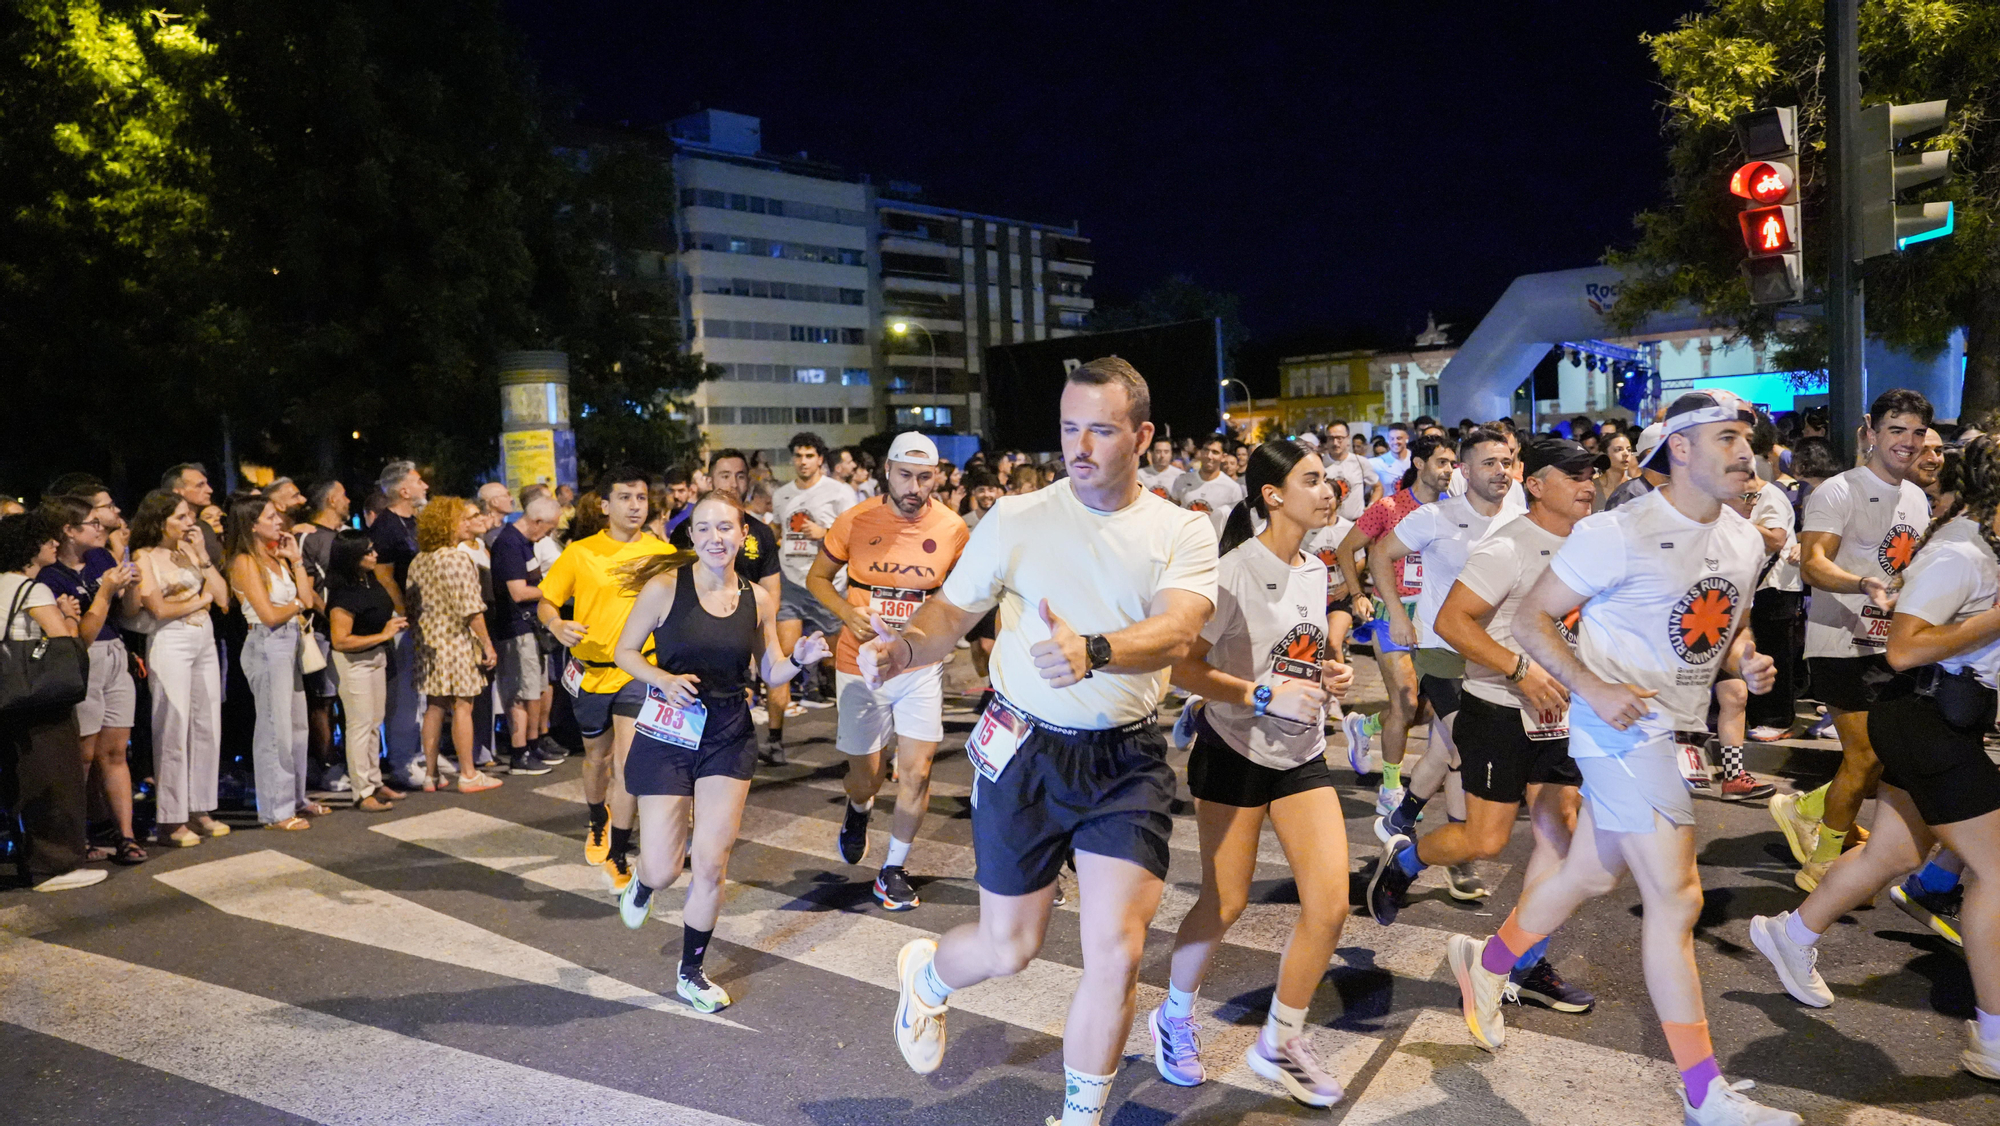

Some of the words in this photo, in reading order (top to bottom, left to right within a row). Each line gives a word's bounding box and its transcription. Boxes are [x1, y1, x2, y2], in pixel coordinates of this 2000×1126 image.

[880, 601, 914, 618] 1360
[1669, 586, 1701, 656] RUNNERS
[1701, 578, 1728, 592] RUN
[1296, 623, 1317, 637] RUN
[653, 703, 686, 730] 783
